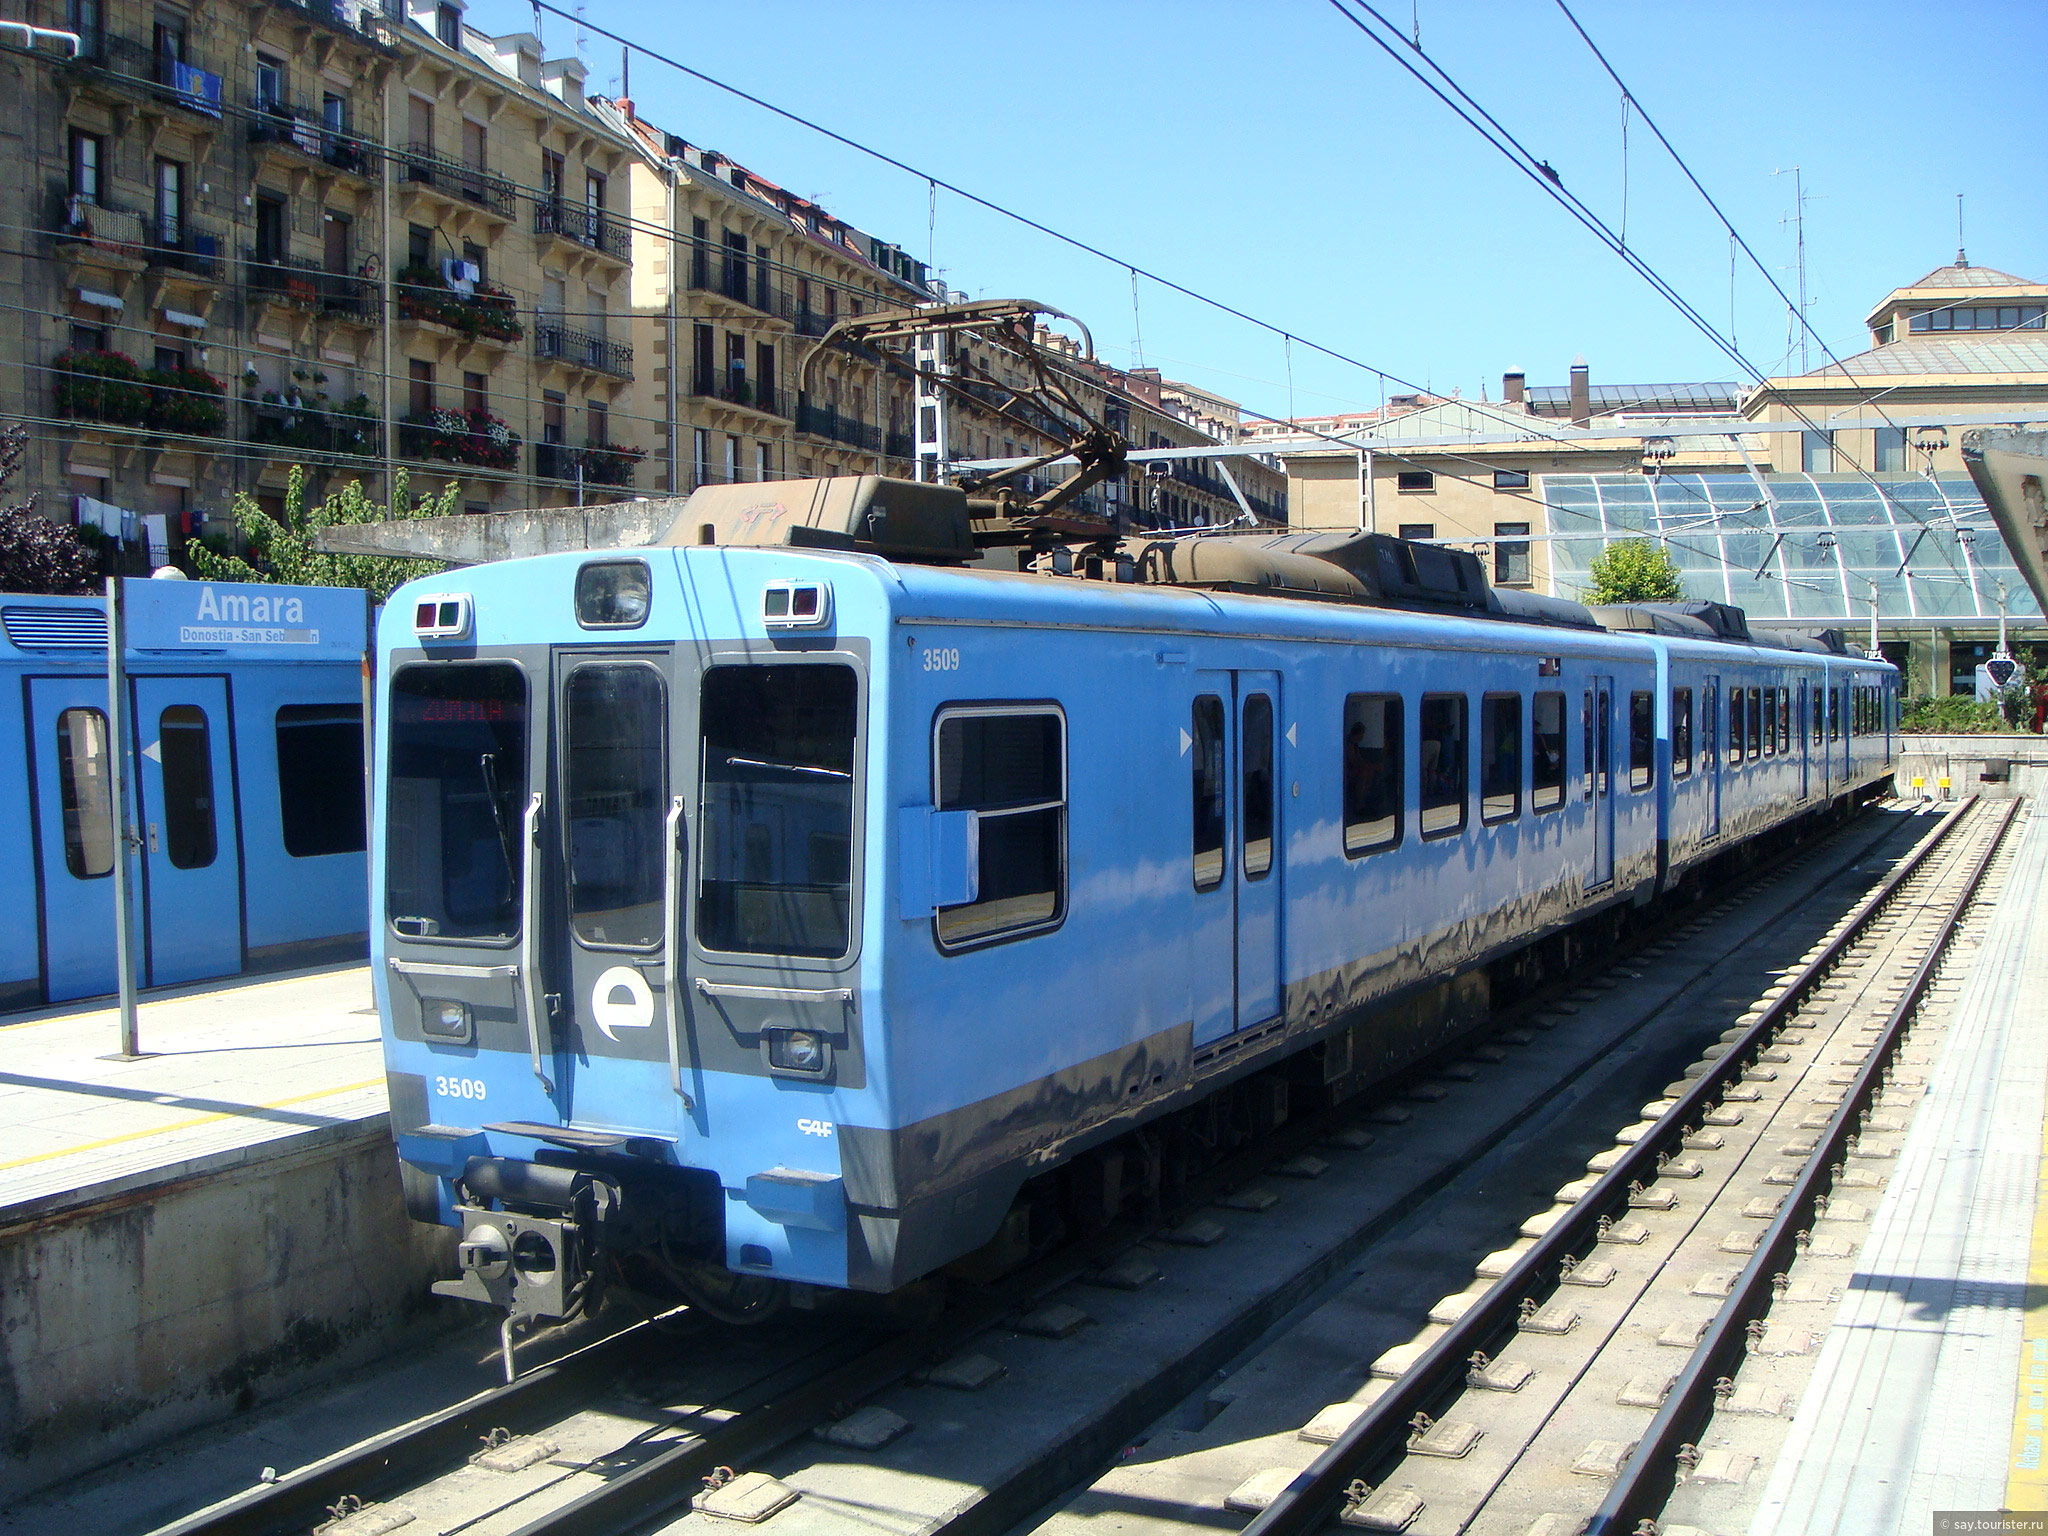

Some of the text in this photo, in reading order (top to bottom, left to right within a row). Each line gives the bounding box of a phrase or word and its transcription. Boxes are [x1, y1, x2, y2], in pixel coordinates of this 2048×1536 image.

[197, 586, 304, 623] Amara
[182, 628, 233, 642] Donostia
[241, 630, 262, 642] San
[923, 648, 960, 671] 3509
[435, 1075, 487, 1101] 3509
[797, 1118, 833, 1138] CAF
